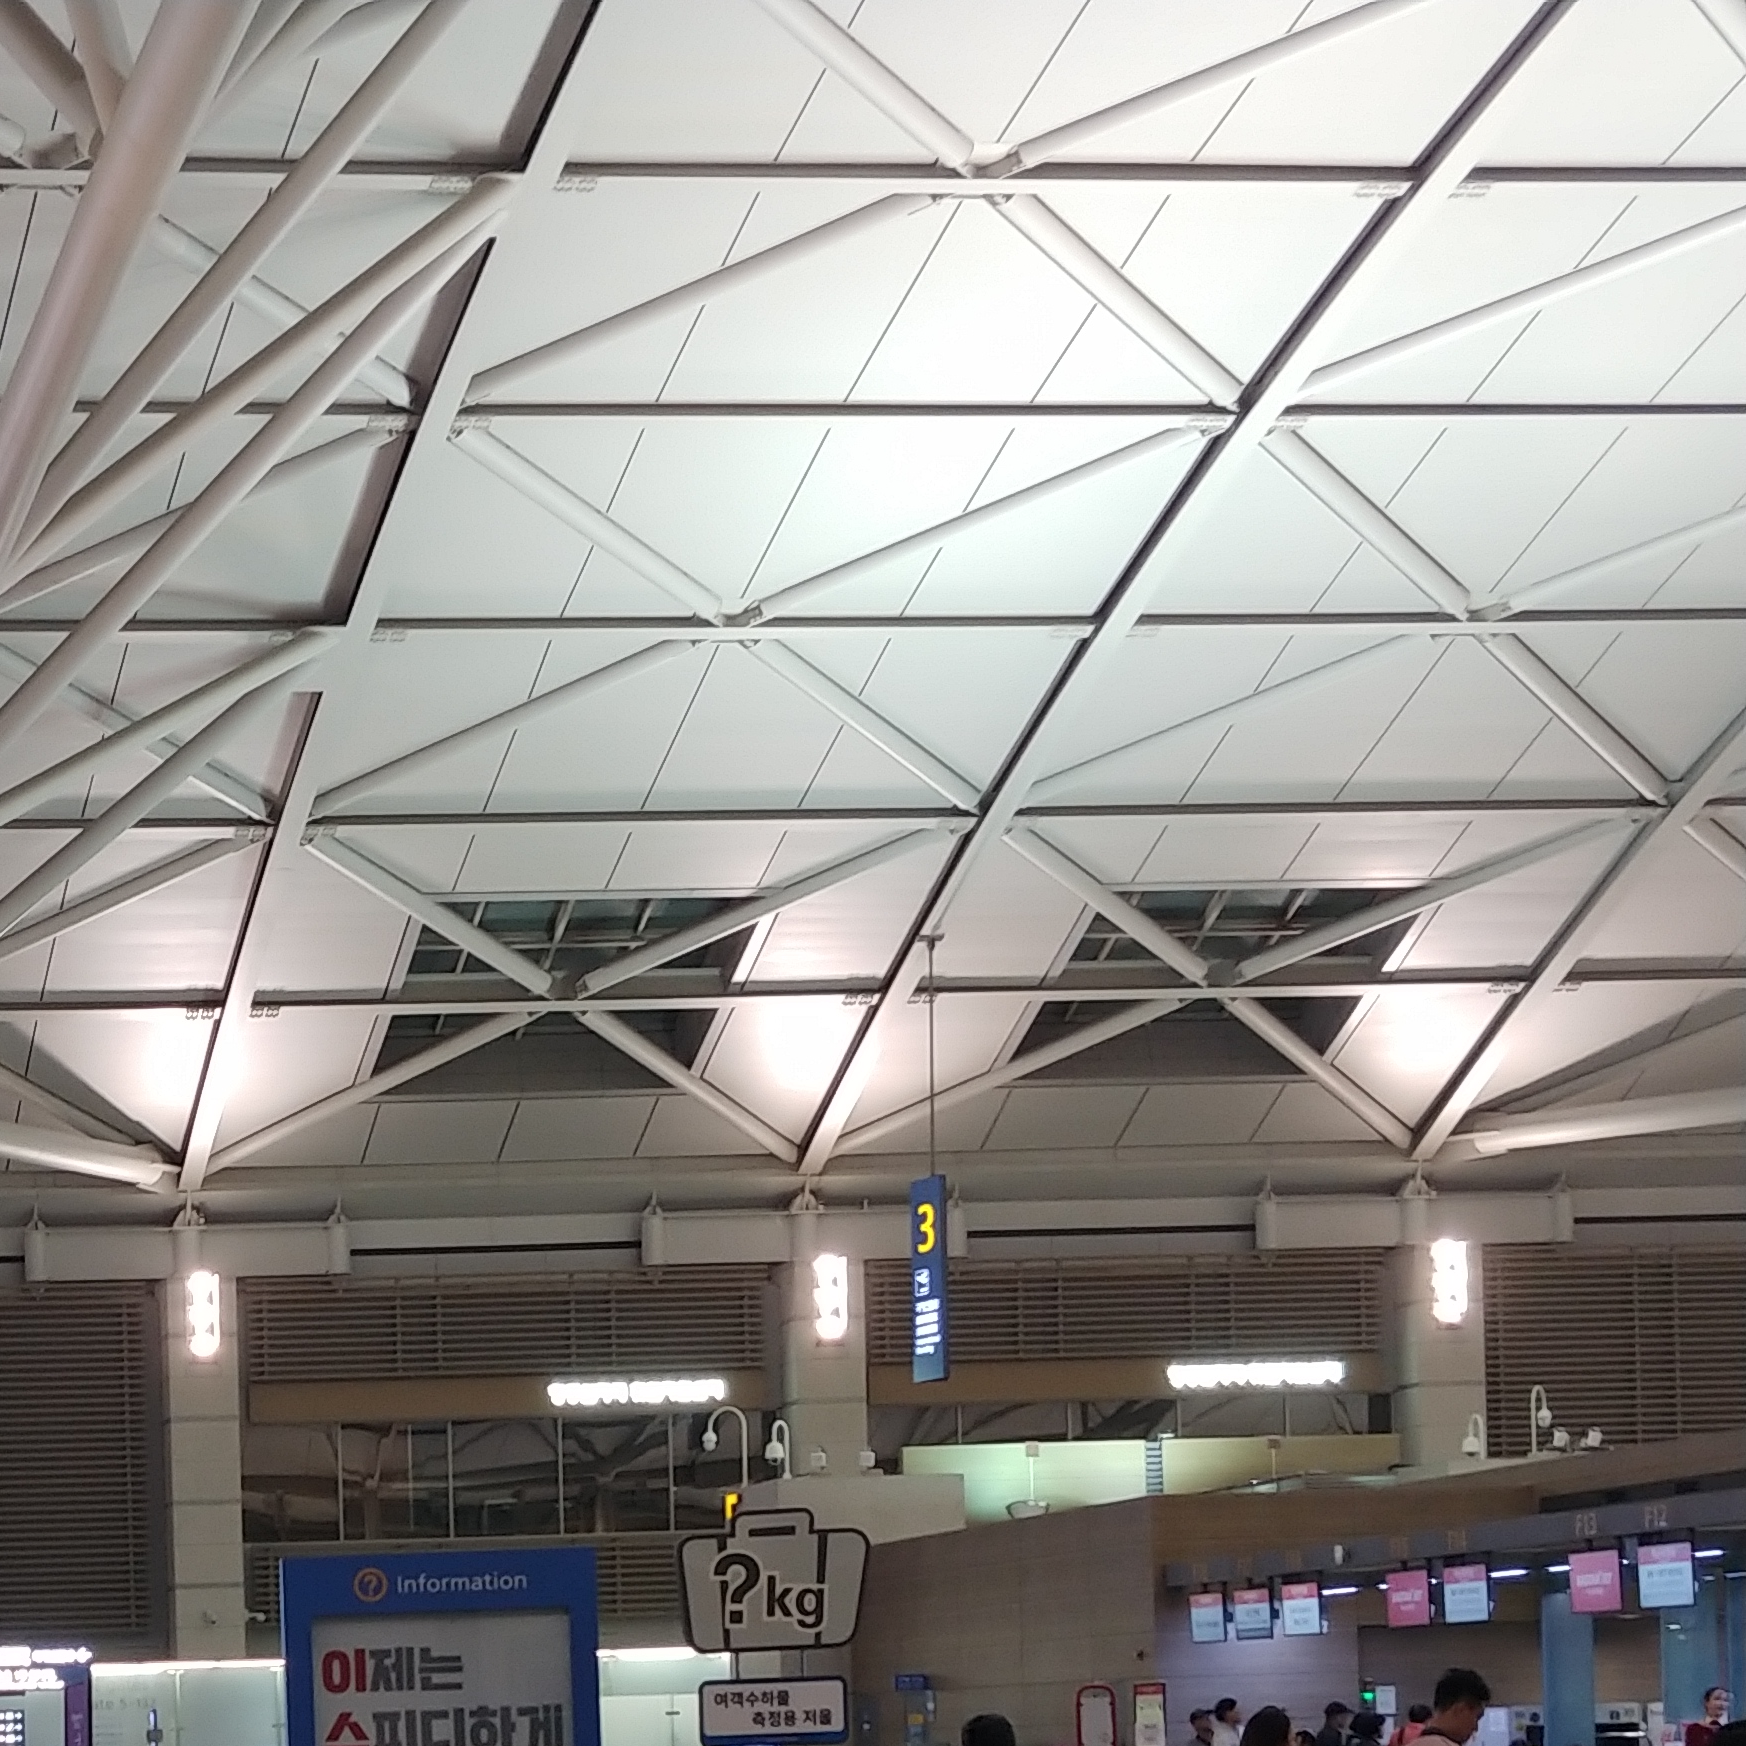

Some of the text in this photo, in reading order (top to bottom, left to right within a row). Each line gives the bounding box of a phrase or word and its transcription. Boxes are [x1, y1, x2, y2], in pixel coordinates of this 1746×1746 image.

[916, 1203, 936, 1254] 3
[1574, 1512, 1598, 1536] F13
[1644, 1504, 1668, 1529] F12
[396, 1573, 529, 1594] Information
[321, 1647, 464, 1693] 이제는
[714, 1690, 790, 1709] 여객수하물
[752, 1708, 832, 1728] 측정용 저울
